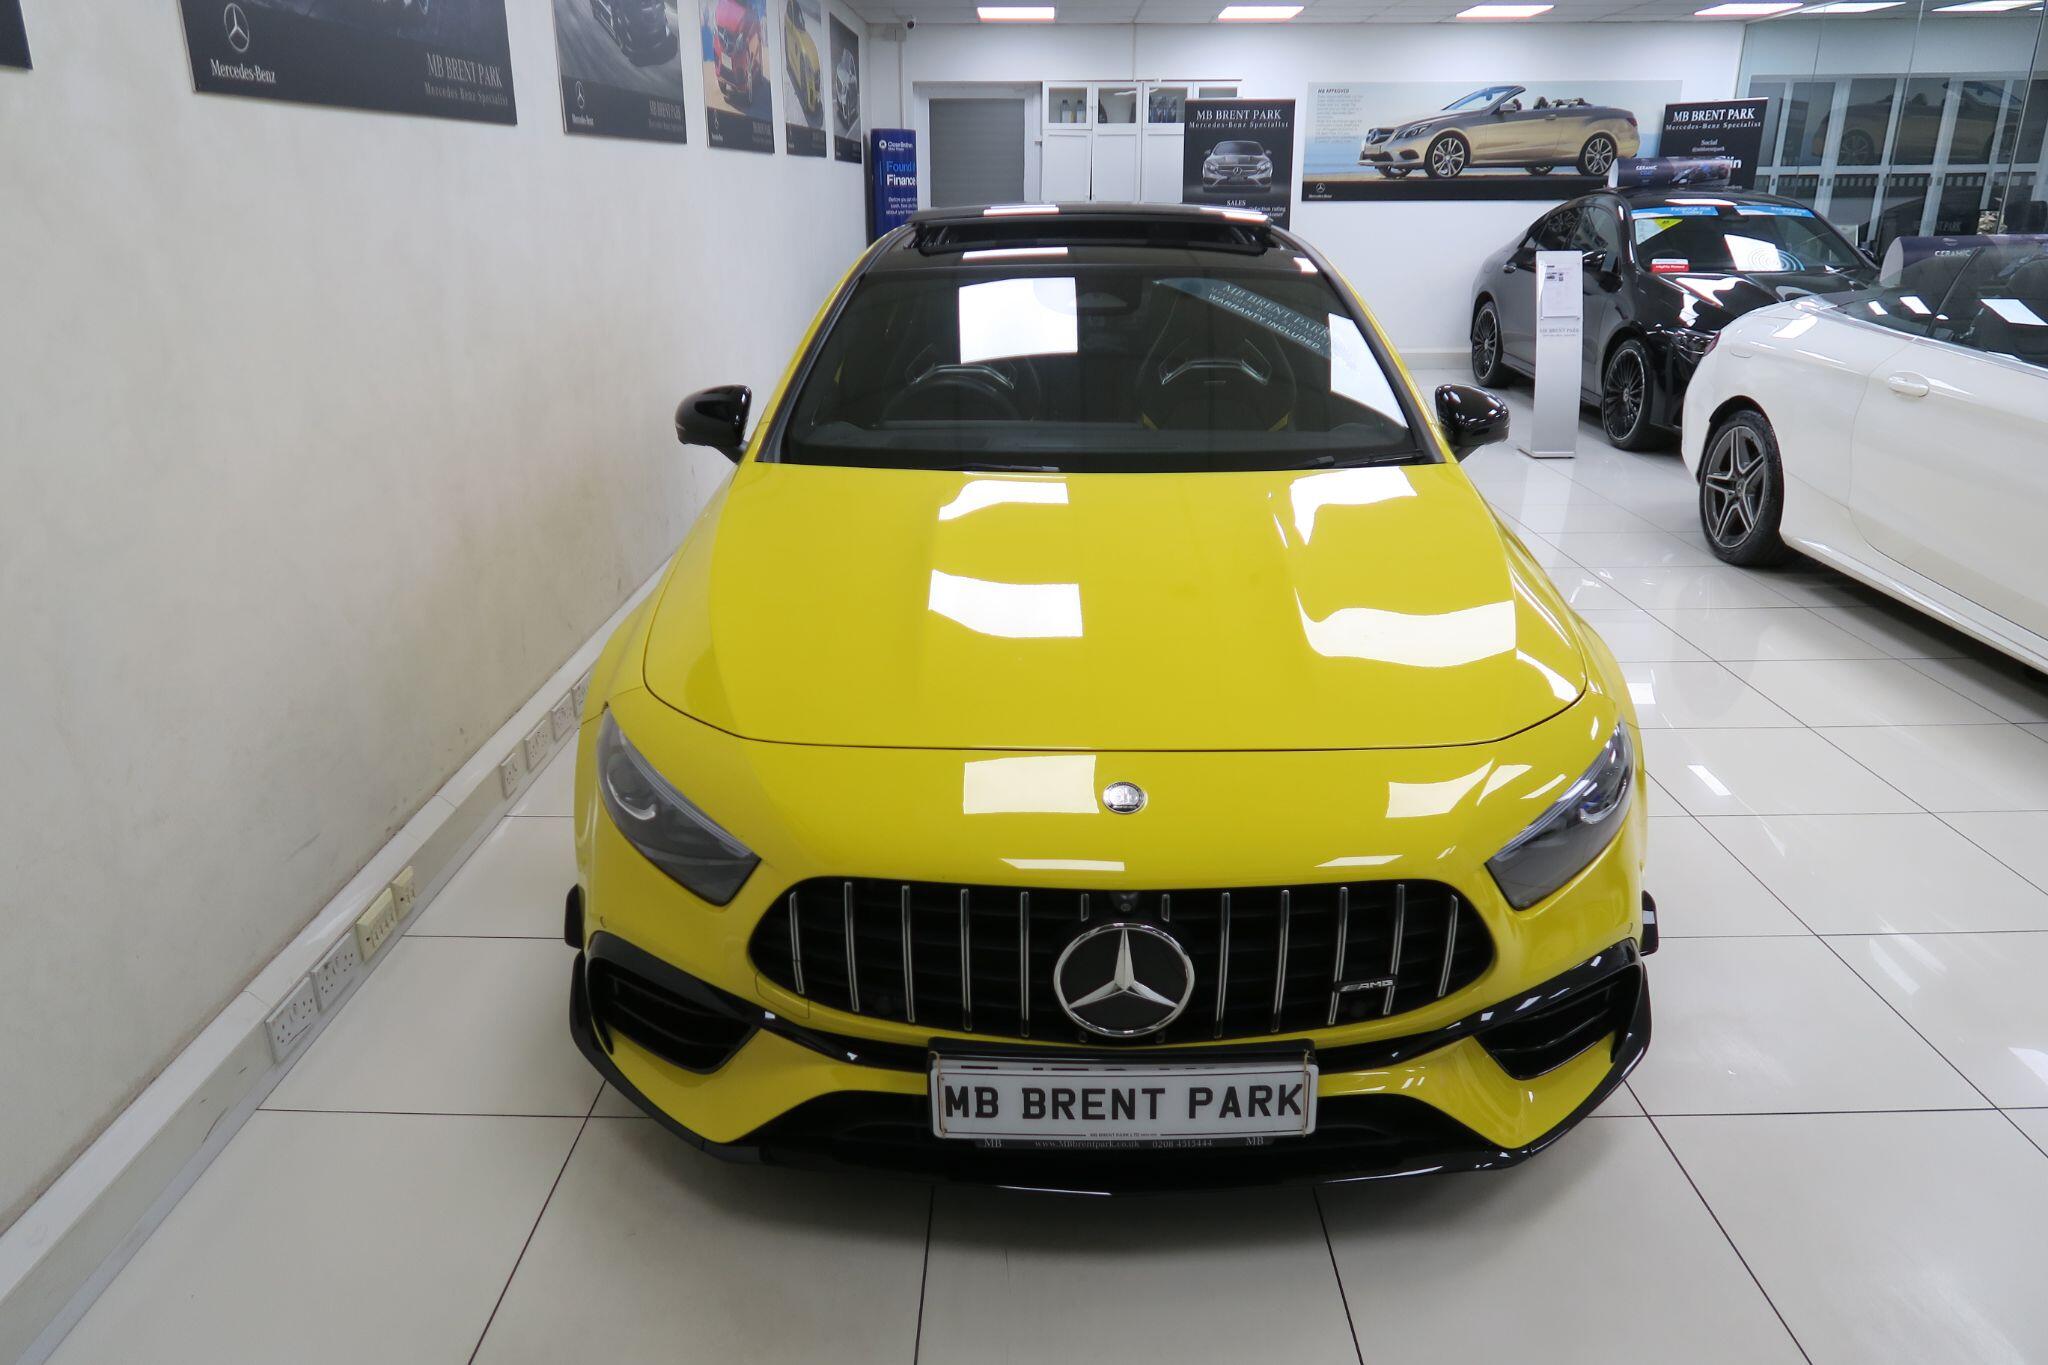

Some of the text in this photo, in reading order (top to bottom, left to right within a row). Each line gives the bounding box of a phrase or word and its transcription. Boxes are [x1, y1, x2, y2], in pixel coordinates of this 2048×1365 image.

[209, 57, 277, 84] Mercedes-Benz
[427, 52, 503, 88] MB BRENT PARK
[1196, 109, 1281, 120] MB BRENT PARK
[1673, 108, 1756, 122] MB BRENT PARK
[1189, 121, 1289, 129] Mercedes-Benz Specialist
[1666, 121, 1761, 131] Mercedes-Benz Specialist
[886, 161, 912, 172] Found
[886, 174, 916, 186] Finance
[1934, 249, 1971, 257] CERAMIC
[1223, 284, 1331, 338] MB BRENT PARK
[1208, 293, 1321, 350] WARRANTY INCLUDED
[945, 1083, 1304, 1120] MB BRENT PARK
[984, 1139, 1002, 1148] MB
[1152, 1139, 1174, 1148] 0208
[1246, 1137, 1264, 1146] MB
